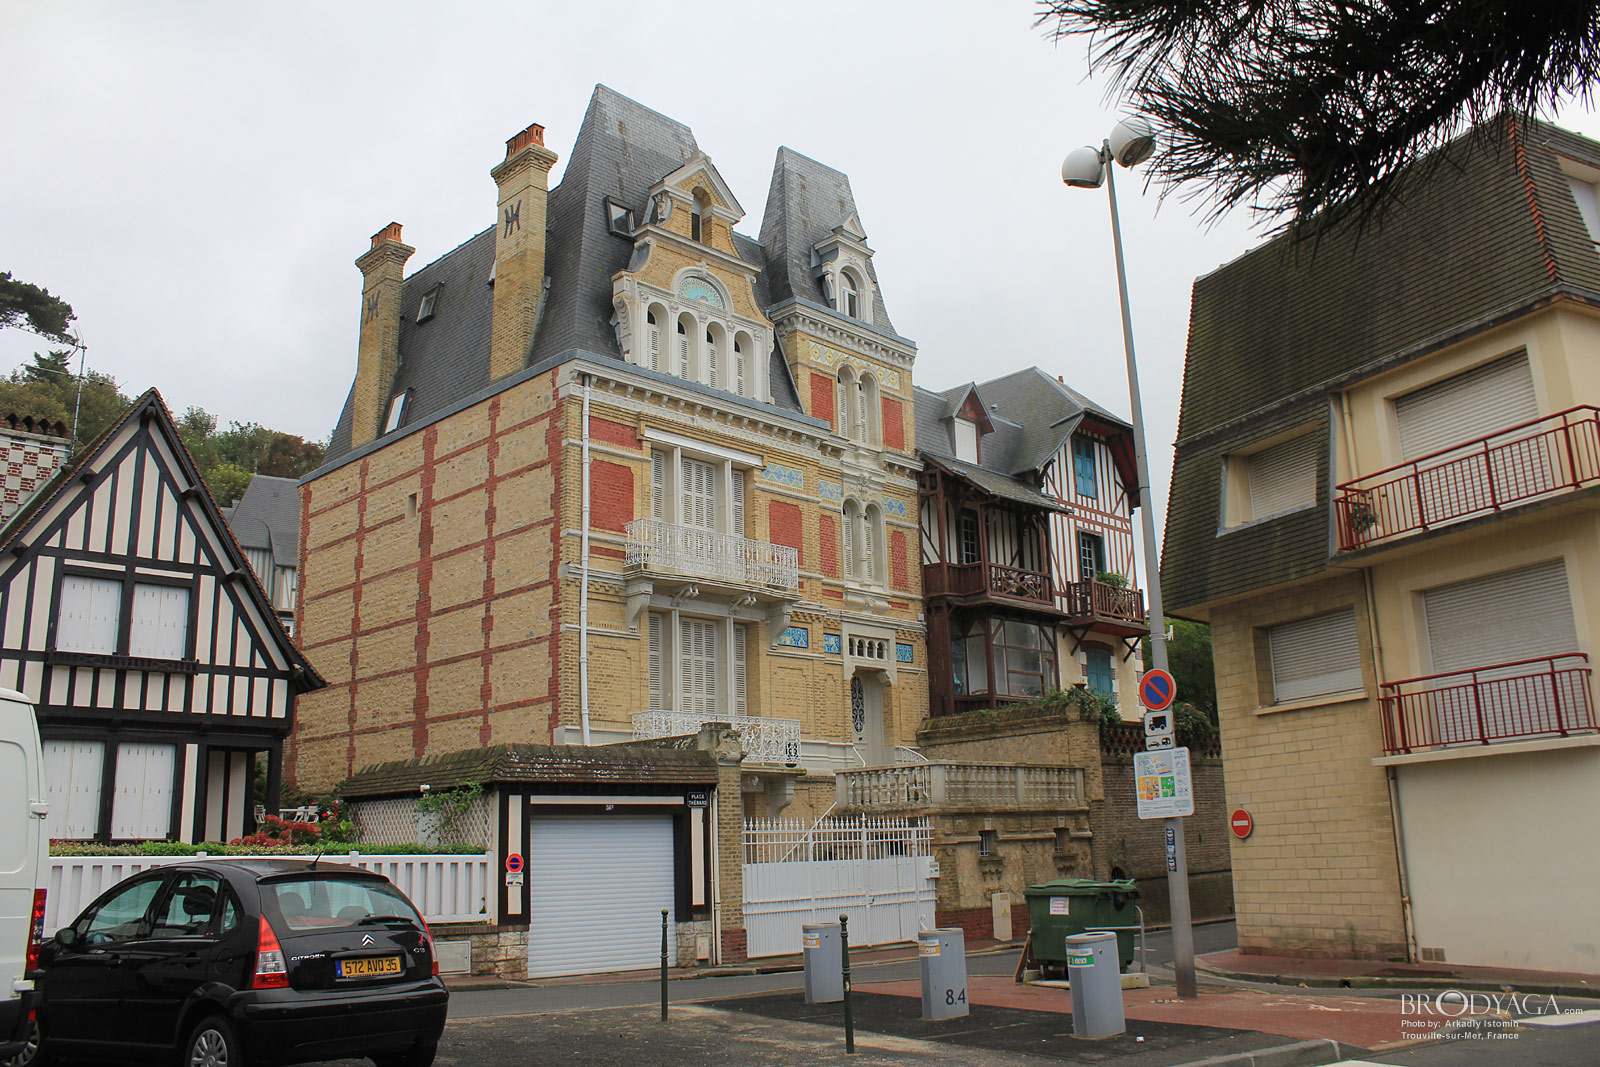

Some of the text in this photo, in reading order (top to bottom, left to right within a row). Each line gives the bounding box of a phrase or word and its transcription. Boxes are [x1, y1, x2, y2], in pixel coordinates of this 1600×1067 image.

[345, 958, 397, 975] 572 AVQ 35
[945, 988, 966, 1006] 8.4
